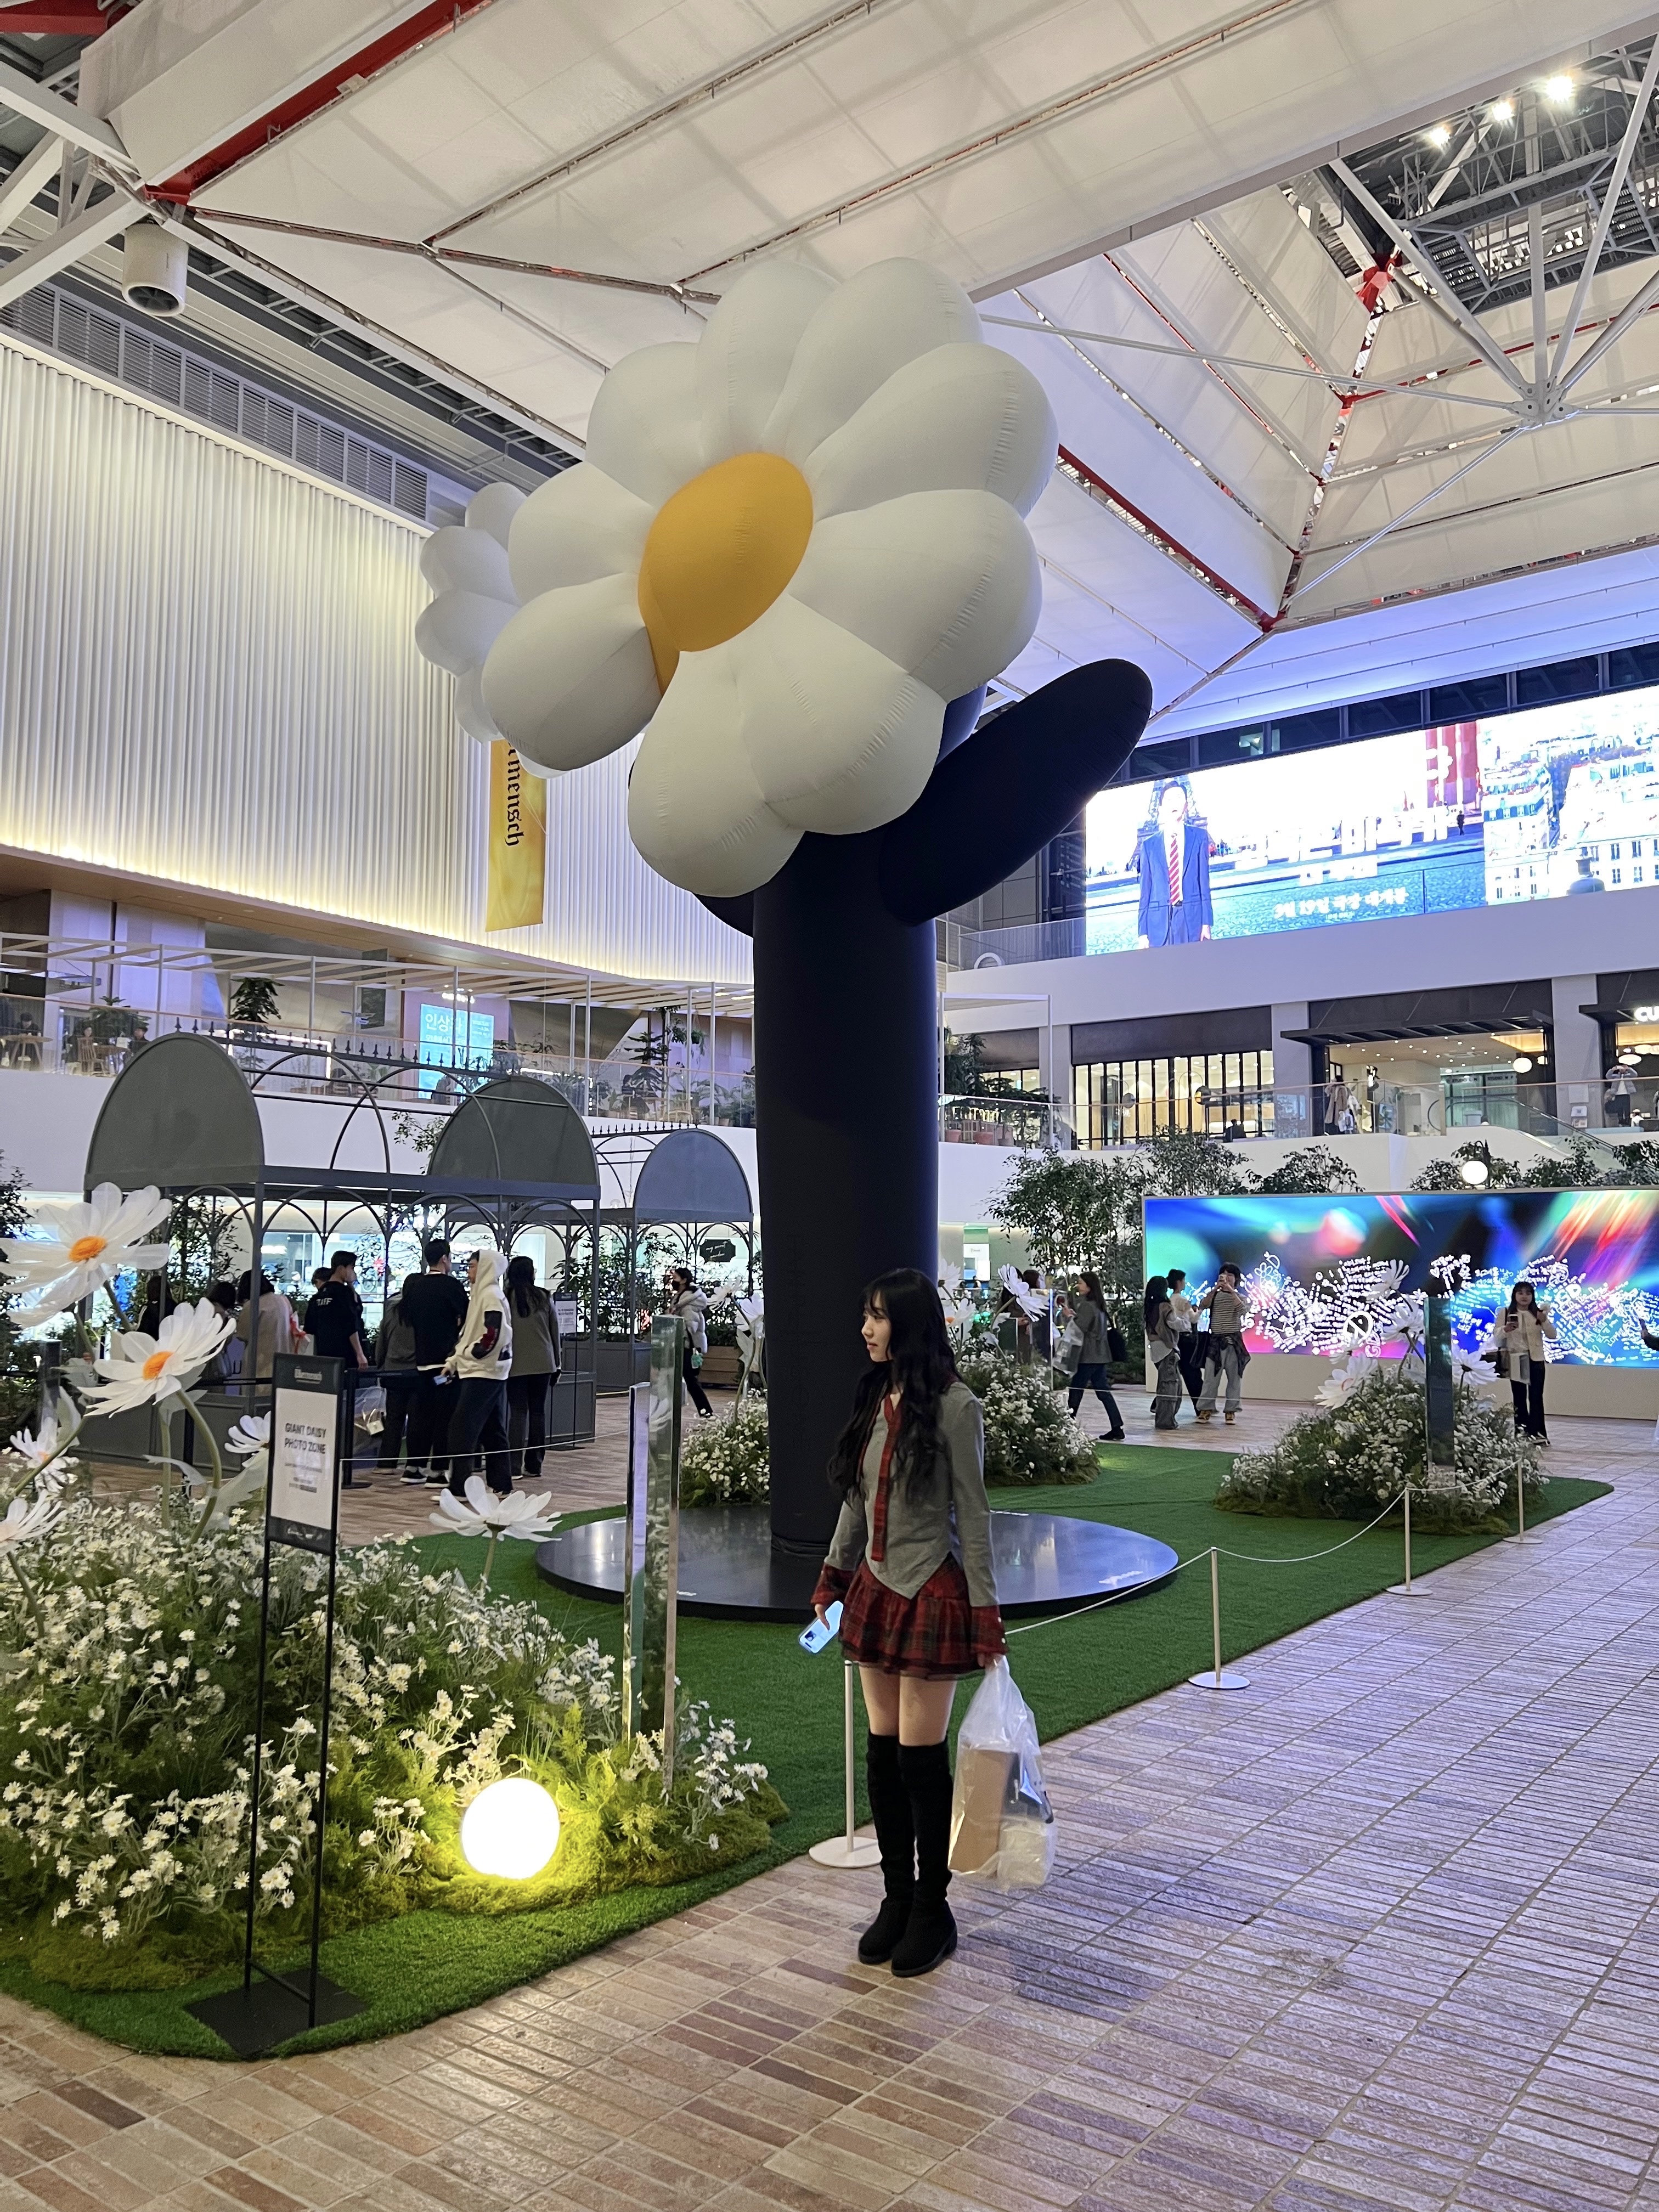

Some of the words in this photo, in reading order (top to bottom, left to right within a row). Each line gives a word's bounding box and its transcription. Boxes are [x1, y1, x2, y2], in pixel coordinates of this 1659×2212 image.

[285, 1423, 306, 1435] GIANT
[284, 1437, 307, 1451] PHOTO
[308, 1442, 326, 1454] ZONE
